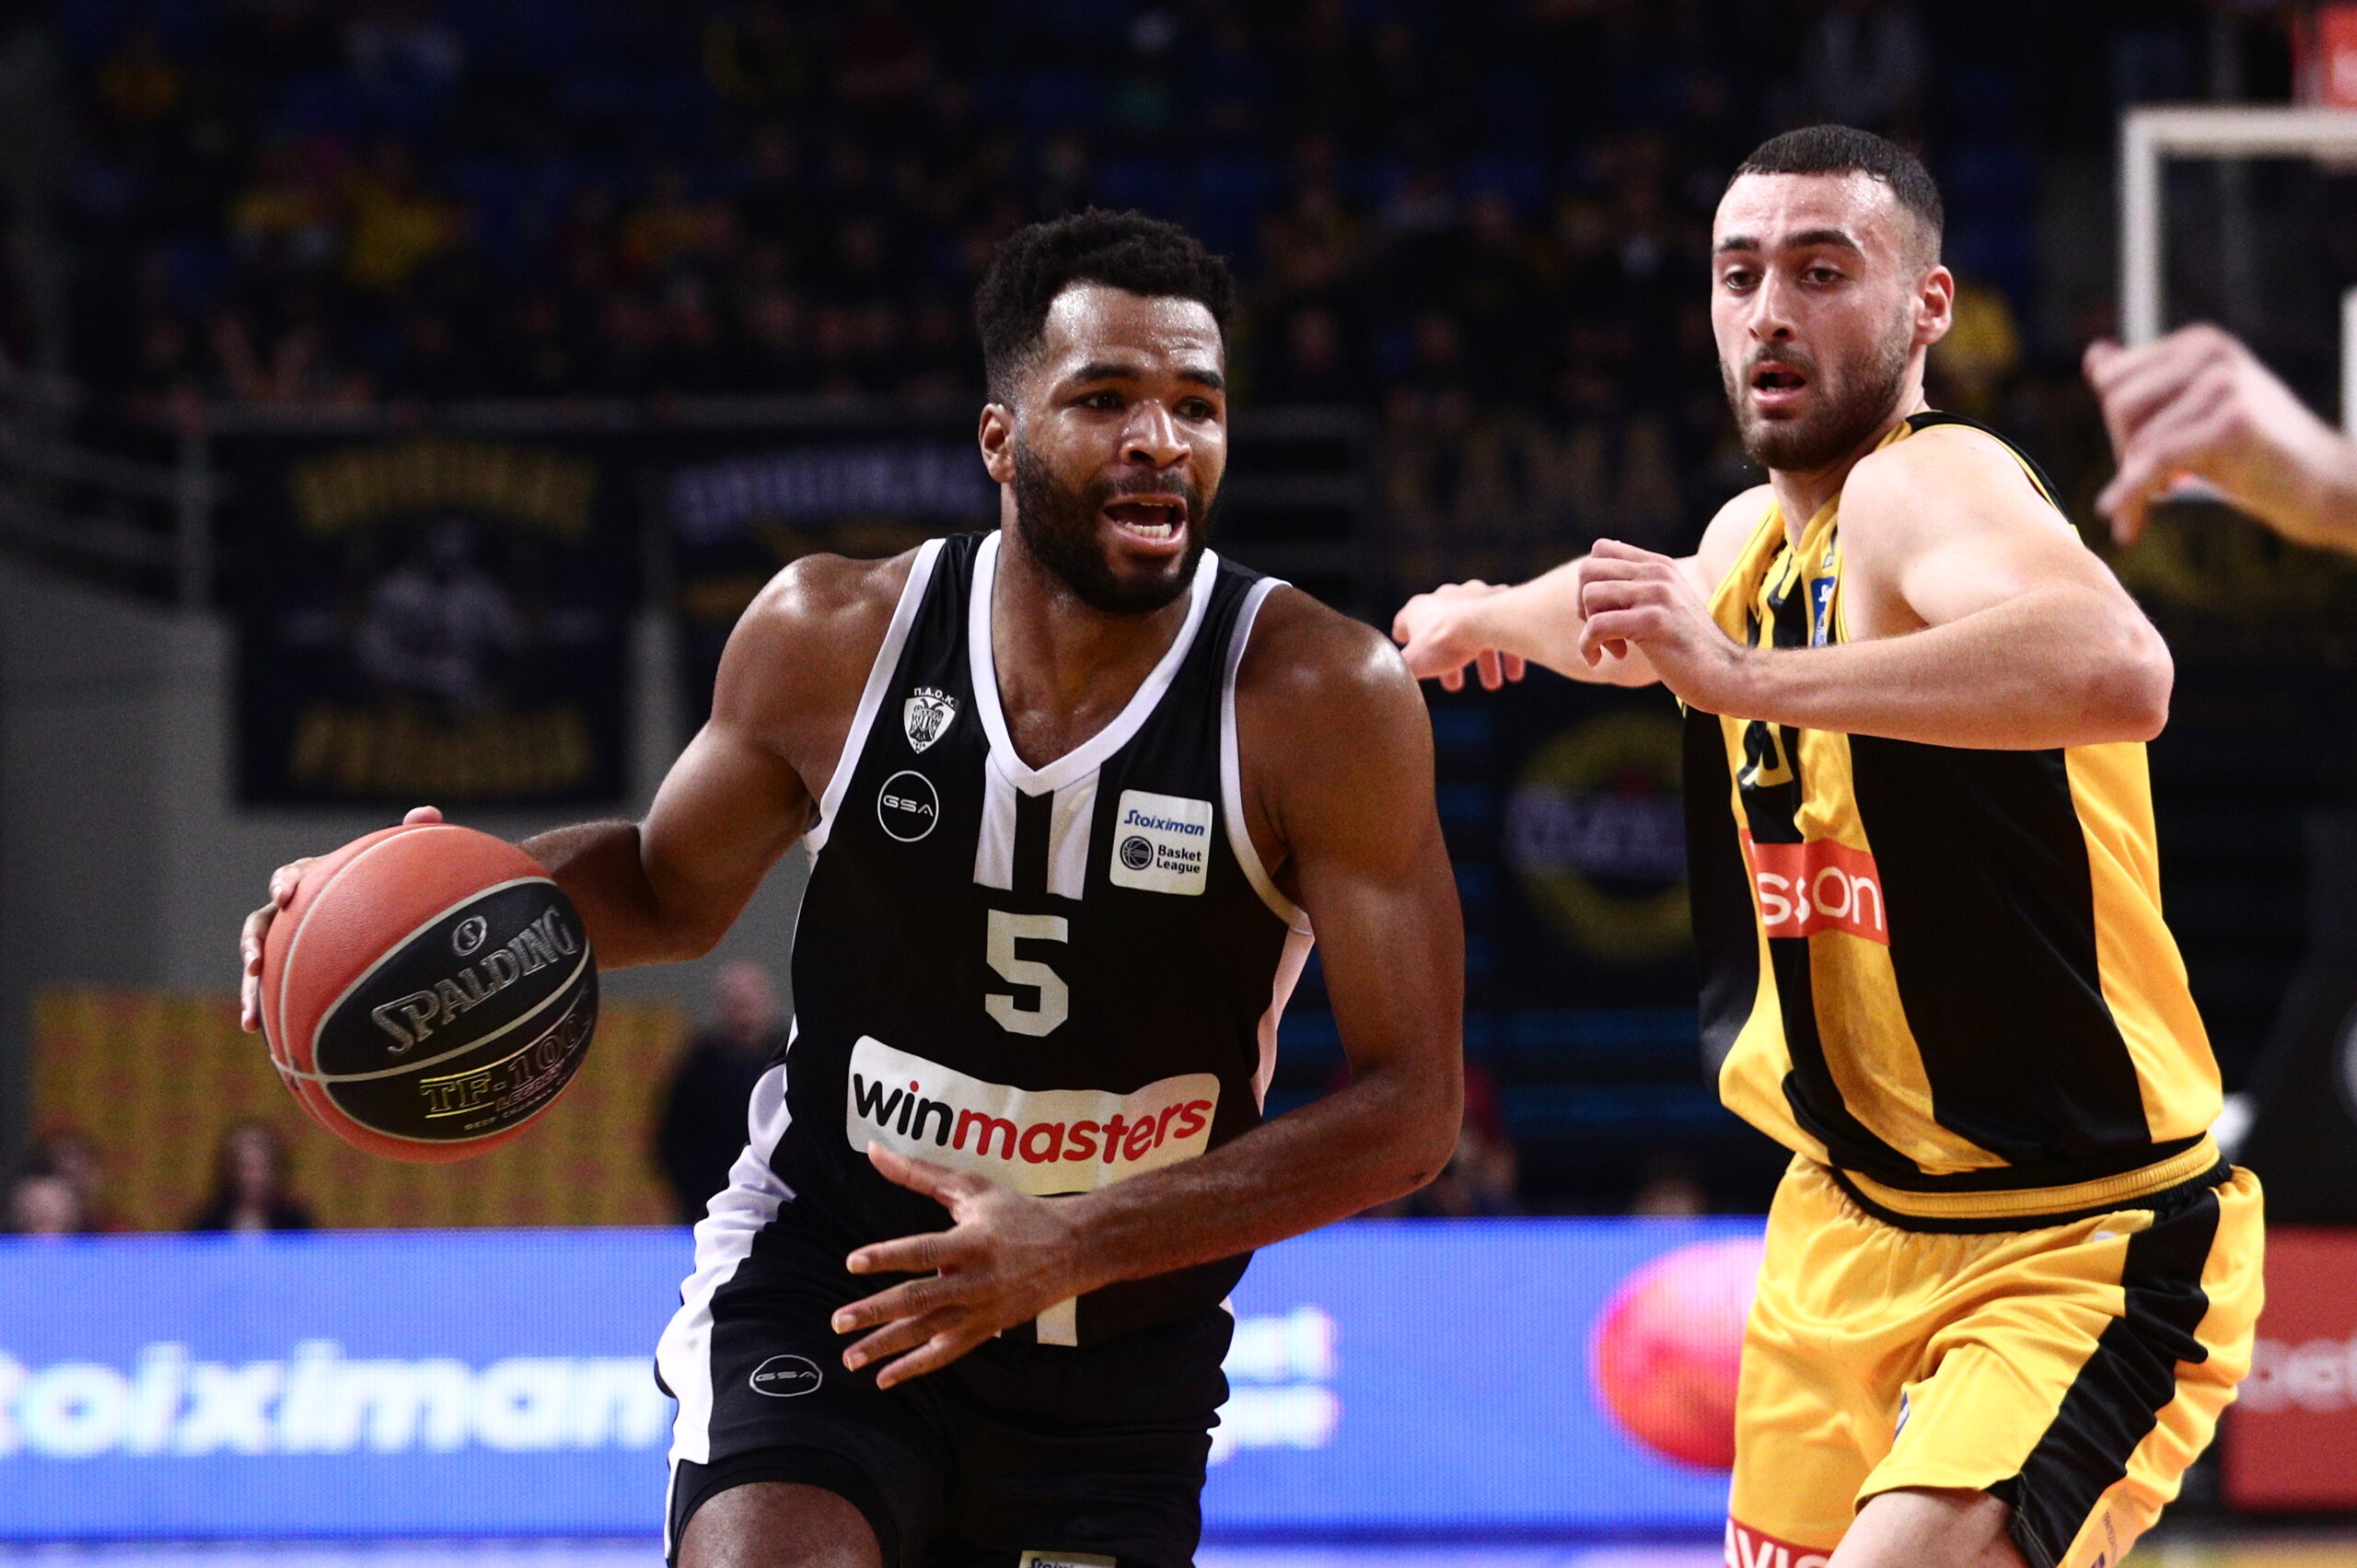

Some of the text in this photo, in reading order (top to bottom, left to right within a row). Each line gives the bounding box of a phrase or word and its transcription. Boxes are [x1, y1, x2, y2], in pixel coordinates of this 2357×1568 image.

[1123, 809, 1206, 837] Stoiximan
[1155, 857, 1201, 875] League
[1157, 844, 1202, 863] Basket
[1750, 840, 1883, 931] sson
[371, 904, 579, 1056] SPALDING
[984, 908, 1069, 1037] 5
[853, 1073, 1213, 1164] winmasters
